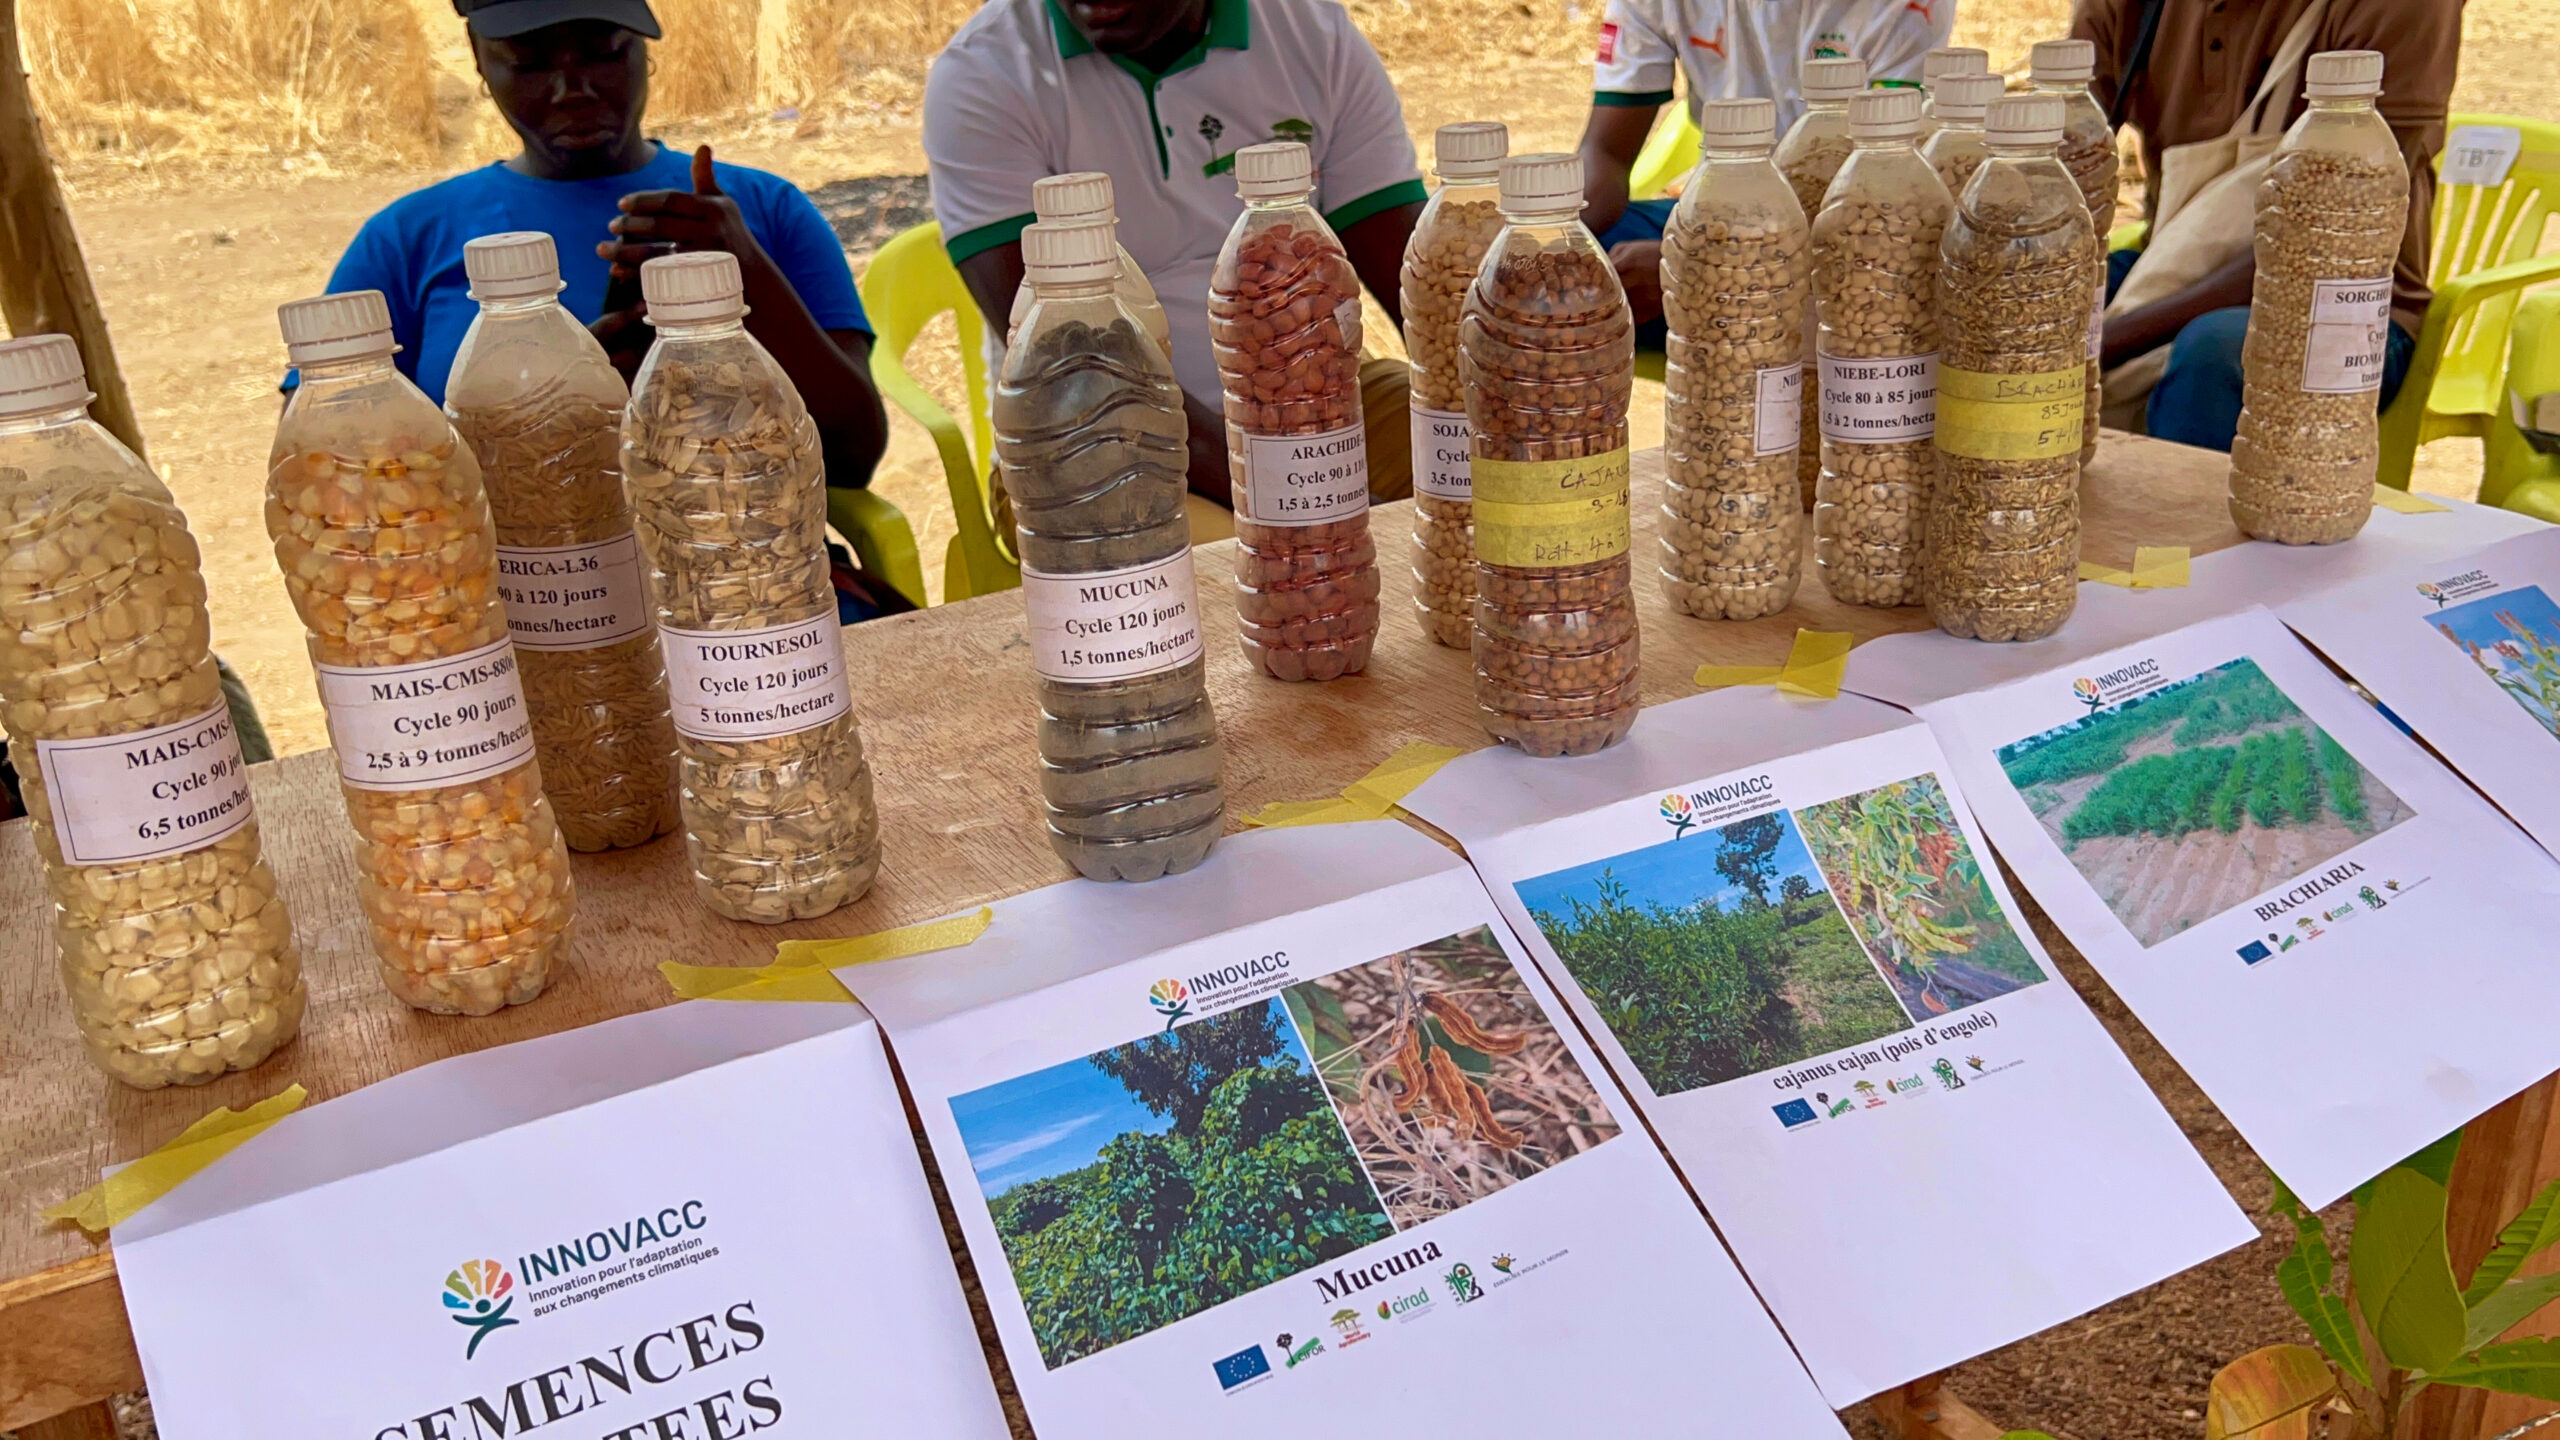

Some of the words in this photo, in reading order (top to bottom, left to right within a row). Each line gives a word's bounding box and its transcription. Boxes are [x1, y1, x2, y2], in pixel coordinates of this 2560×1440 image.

[1782, 370, 1801, 388] NIE
[1834, 363, 1926, 380] NIEBE-LORI
[1825, 388, 1851, 404] Cycle
[1855, 392, 1871, 404] 80
[1875, 391, 1883, 404] à
[1887, 390, 1905, 404] 85
[1908, 388, 1937, 404] jour
[1843, 416, 1849, 427] 2
[1287, 471, 1326, 488] Cycle
[1329, 466, 1343, 480] 90
[1345, 464, 1352, 477] à
[1431, 471, 1447, 486] 3,5
[1278, 498, 1298, 512] 1,5
[1301, 497, 1310, 509] à
[1314, 494, 1333, 510] 2,5
[497, 586, 512, 602] 90
[516, 589, 525, 604] à
[529, 589, 558, 605] 120
[563, 586, 608, 607] jours
[1080, 575, 1169, 603] MUCUNA
[1065, 618, 1113, 638] Cycle
[1119, 611, 1148, 631] 120
[1152, 601, 1186, 628] jours
[697, 630, 823, 662] TOURNESOL
[1061, 650, 1083, 668] 1,5
[1088, 628, 1195, 665] tonnes/hectare
[699, 676, 749, 696] Cycle
[756, 671, 787, 690] 120
[791, 662, 829, 688] jours
[2095, 658, 2159, 690] INNOVACC
[394, 712, 452, 737] Cycle
[457, 704, 479, 724] 90
[484, 694, 517, 722] jours
[701, 708, 710, 723] 5
[715, 691, 835, 724] tonnes/hectare
[366, 752, 393, 772] 2,5
[399, 751, 411, 768] à
[417, 751, 428, 766] 9
[152, 772, 208, 800] Cycle
[210, 760, 227, 781] 90
[1690, 775, 1773, 809] INNOVACC
[138, 817, 171, 840] 6,5
[2253, 861, 2366, 922] BRACHIARIA
[1188, 951, 1290, 995] INNOVACC
[1773, 1060, 1837, 1090] cajanus
[1837, 1049, 1882, 1072] cajan
[1882, 1034, 1923, 1062] (pois
[1923, 1010, 1998, 1043] d'engole)
[518, 1200, 707, 1285] INNOVACC
[528, 1272, 597, 1303] Innovation
[598, 1261, 627, 1282] pour
[629, 1236, 703, 1269] l'adaptation
[533, 1302, 558, 1317] aux
[559, 1273, 646, 1309] changements
[647, 1245, 720, 1277] climatiques
[1313, 1240, 1443, 1304] Mucuna
[1392, 1286, 1430, 1315] cirad
[374, 1300, 764, 1440] EMENCES
